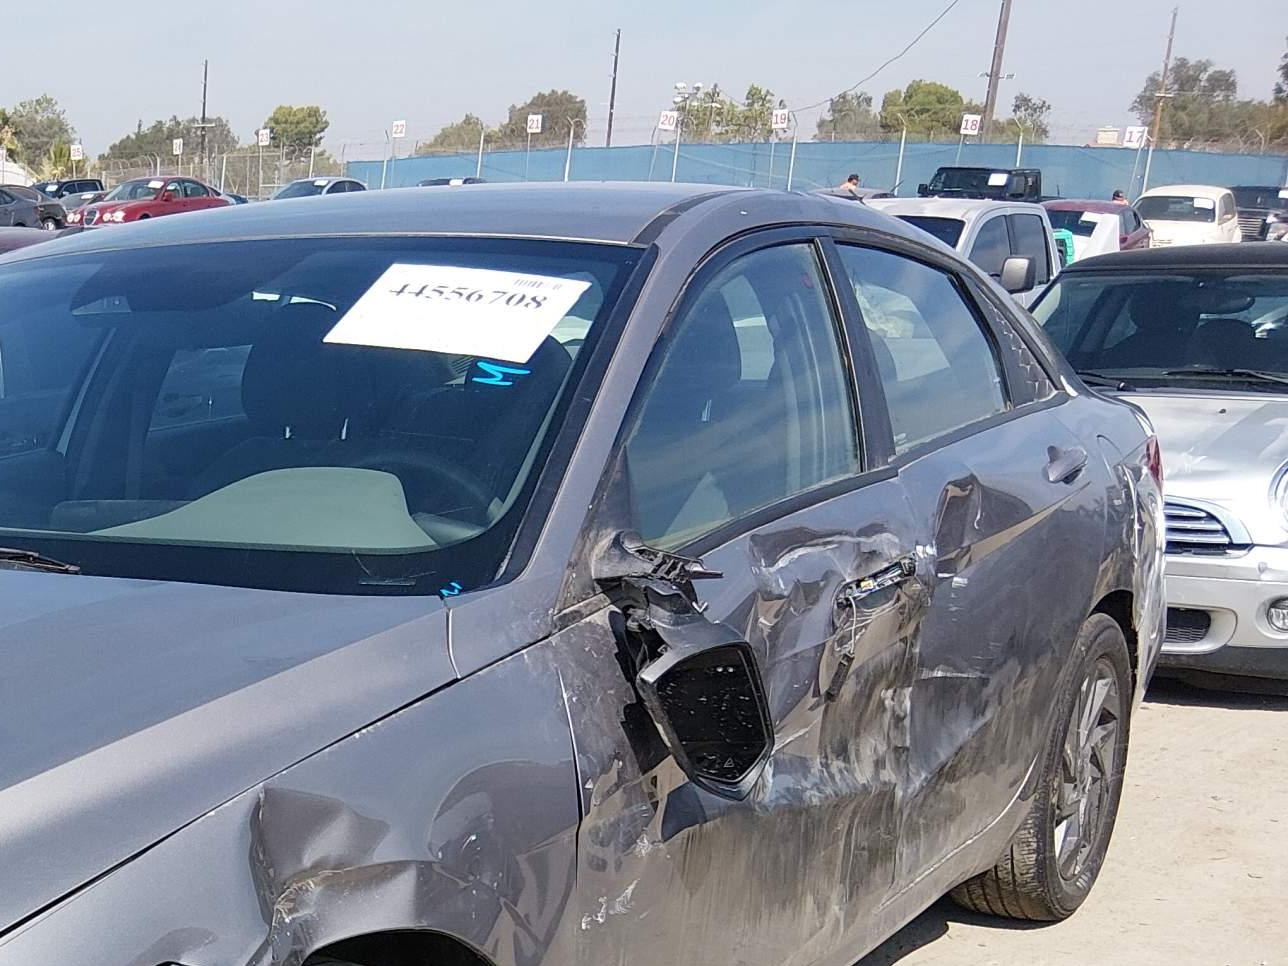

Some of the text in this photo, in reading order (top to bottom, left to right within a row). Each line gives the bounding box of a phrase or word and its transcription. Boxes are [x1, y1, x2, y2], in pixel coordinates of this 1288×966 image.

[528, 119, 540, 130] 21
[661, 114, 674, 126] 20
[774, 113, 787, 125] 19
[962, 118, 978, 131] 18
[394, 124, 404, 135] 22
[1126, 130, 1144, 143] 17
[389, 282, 548, 309] 44556708
